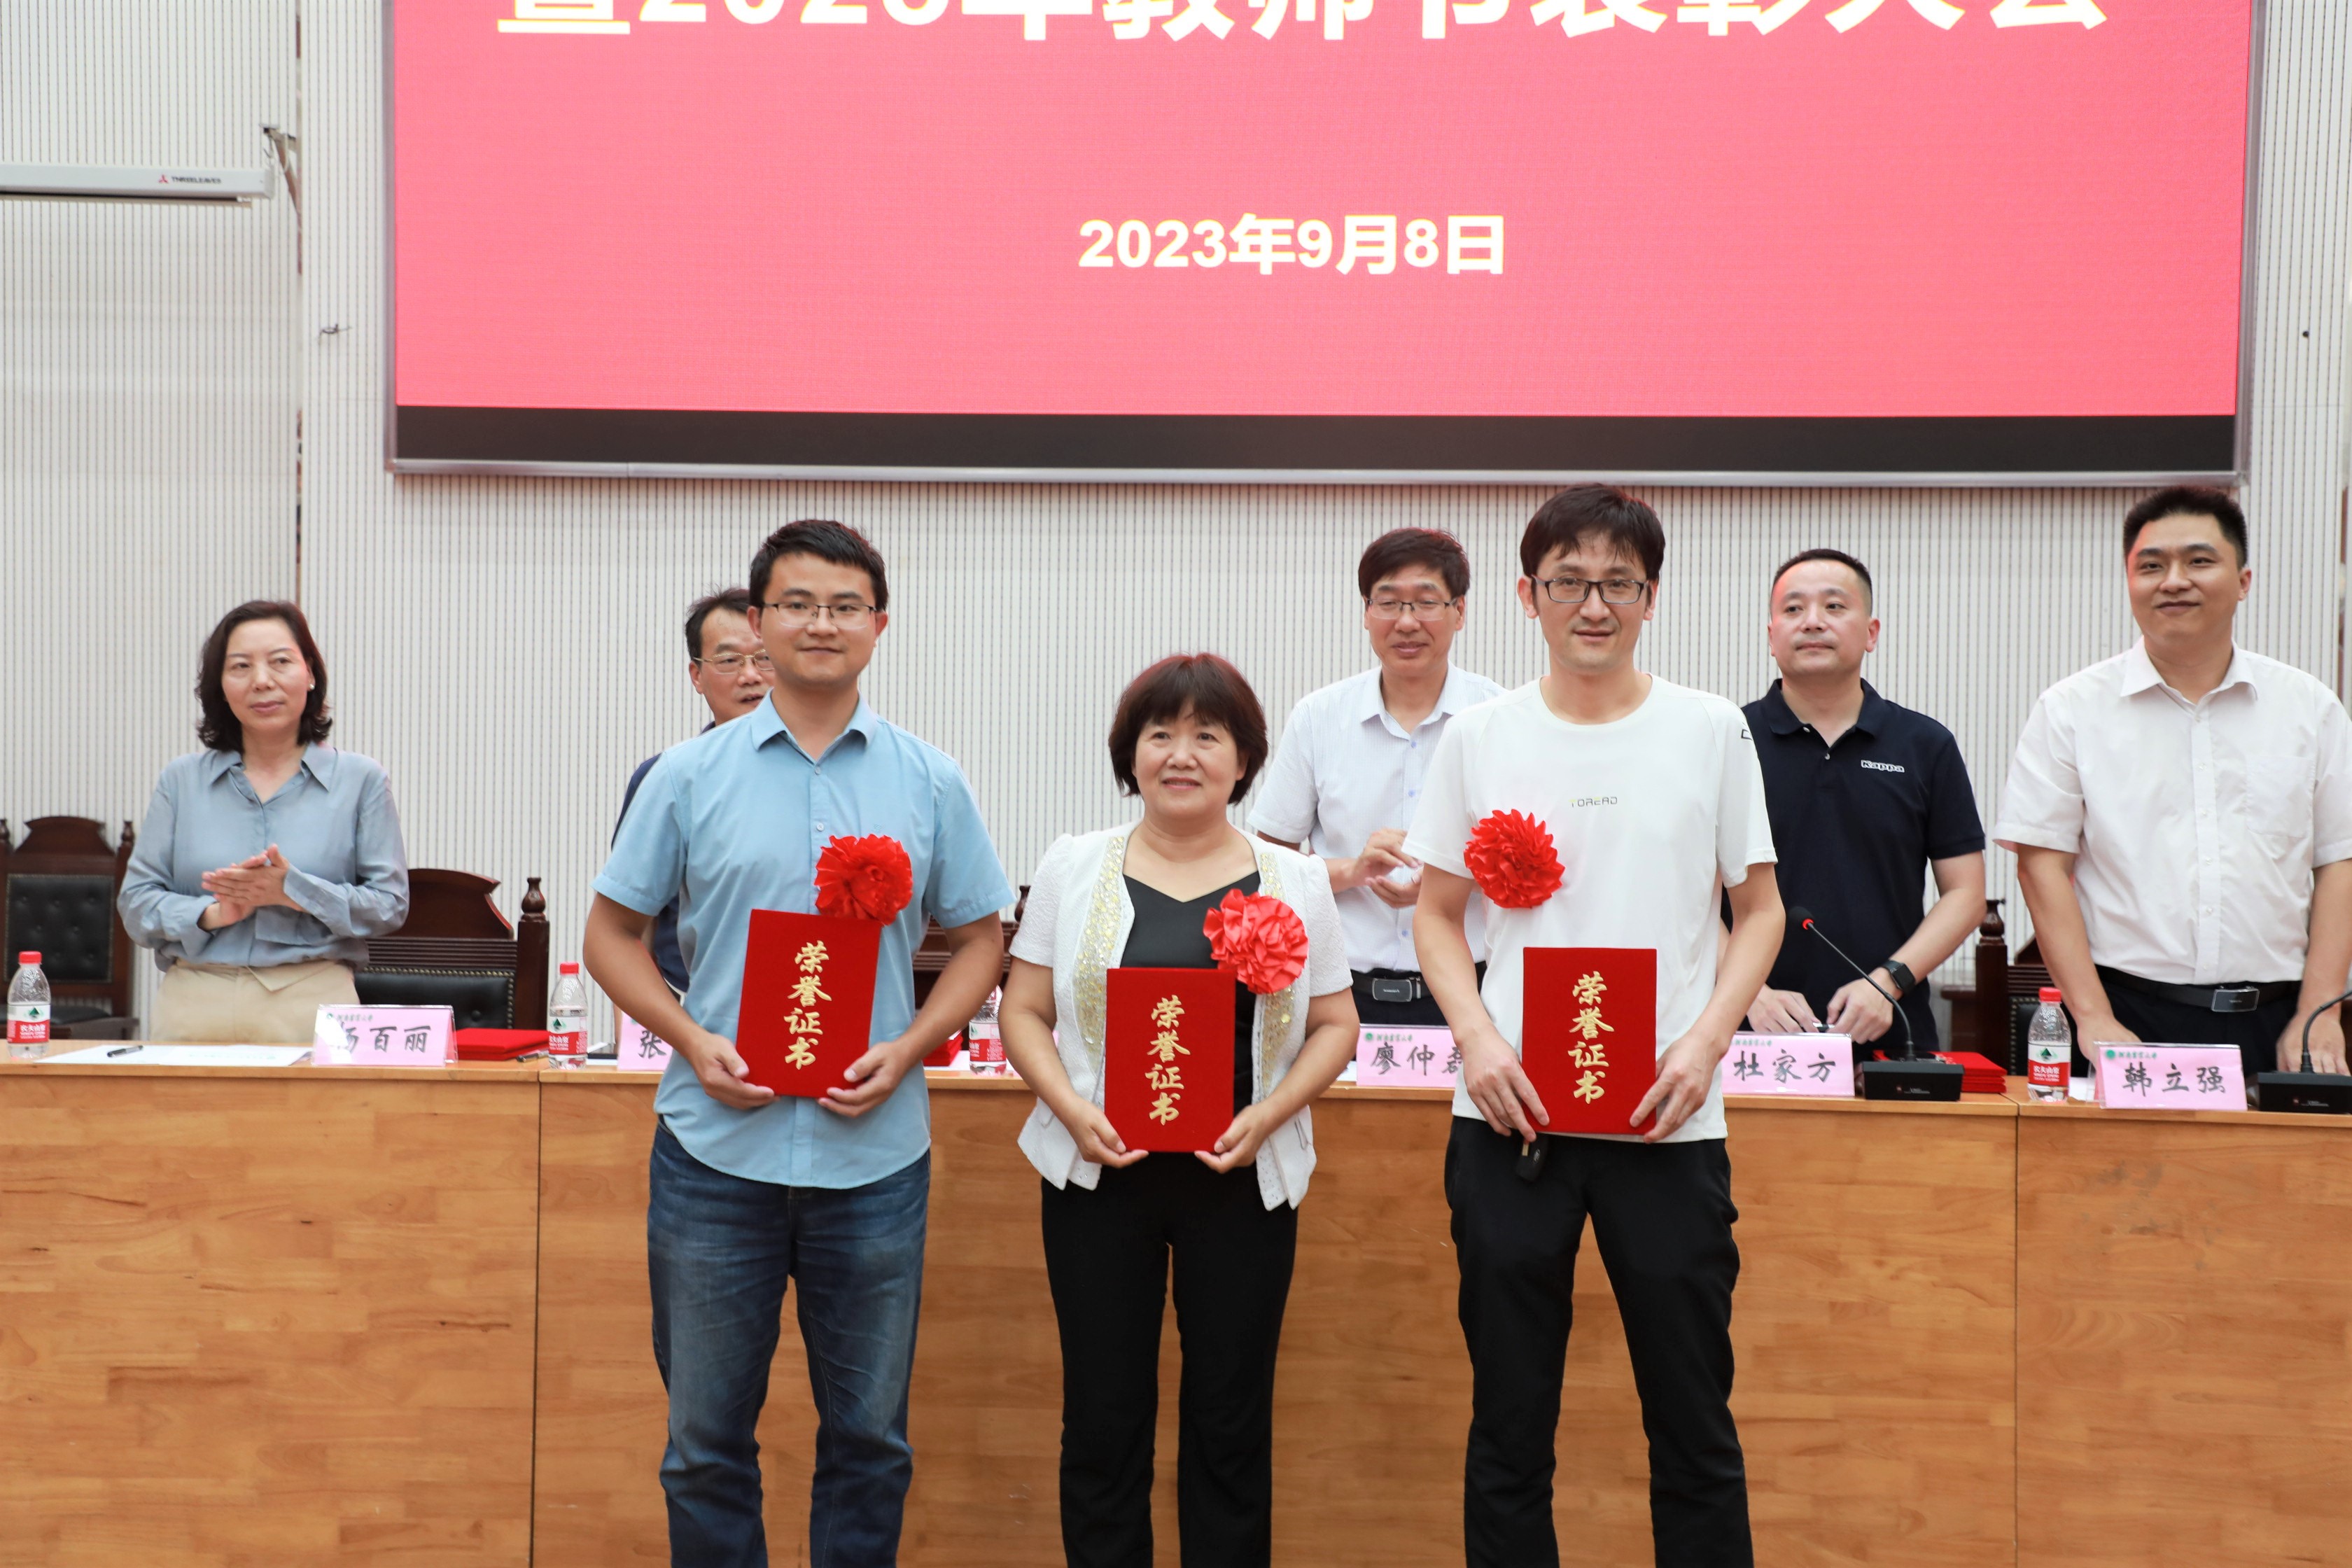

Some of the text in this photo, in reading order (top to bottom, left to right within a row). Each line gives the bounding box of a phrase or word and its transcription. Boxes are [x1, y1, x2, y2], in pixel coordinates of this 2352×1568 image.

[1079, 212, 1504, 275] 2023年9月8日
[1861, 760, 1905, 773] Kappa
[1569, 796, 1618, 808] TOREAD
[783, 940, 832, 1070] 荣誉证书
[638, 1030, 667, 1059] 张
[1567, 971, 1615, 1105] 荣誉证书
[1144, 995, 1191, 1126] 荣誉证书
[1733, 1049, 1836, 1084] 杜家方
[2122, 1061, 2226, 1097] 韩立强
